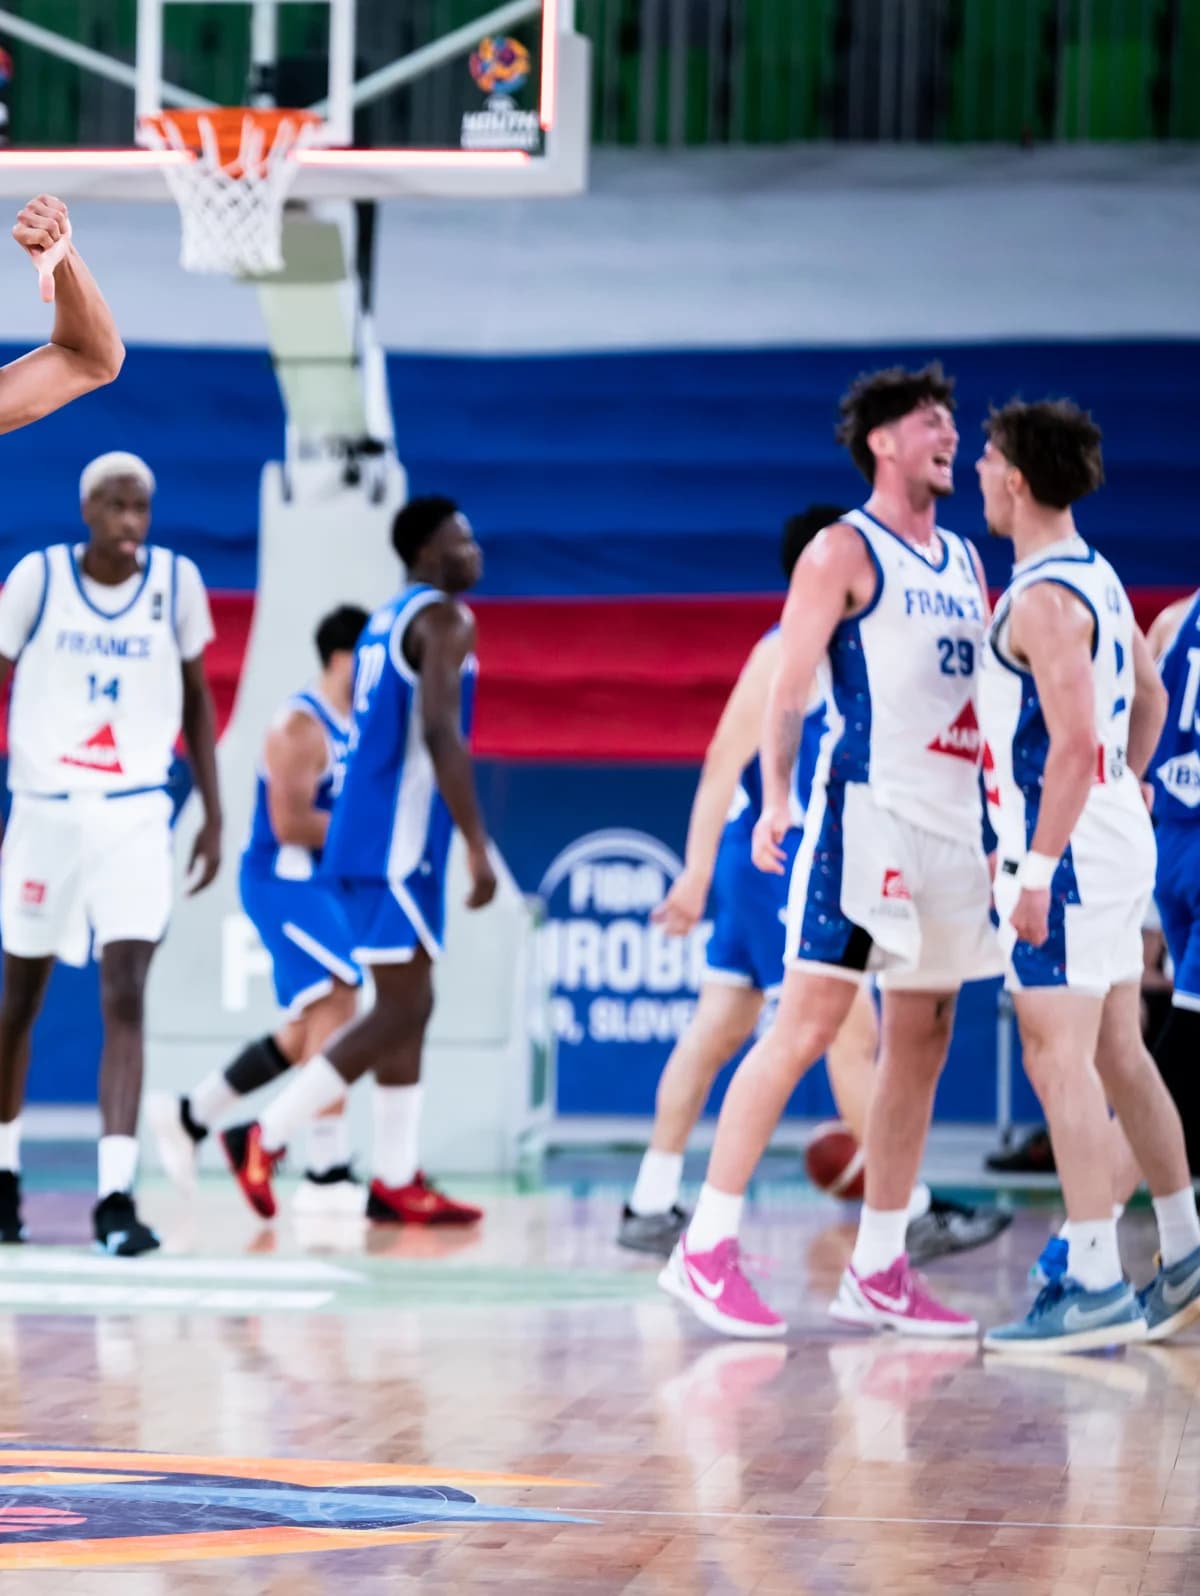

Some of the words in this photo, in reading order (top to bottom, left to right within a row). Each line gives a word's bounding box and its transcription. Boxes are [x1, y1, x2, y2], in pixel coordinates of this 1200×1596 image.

[56, 630, 151, 660] FRANCE
[937, 636, 976, 677] 29
[86, 673, 121, 703] 14
